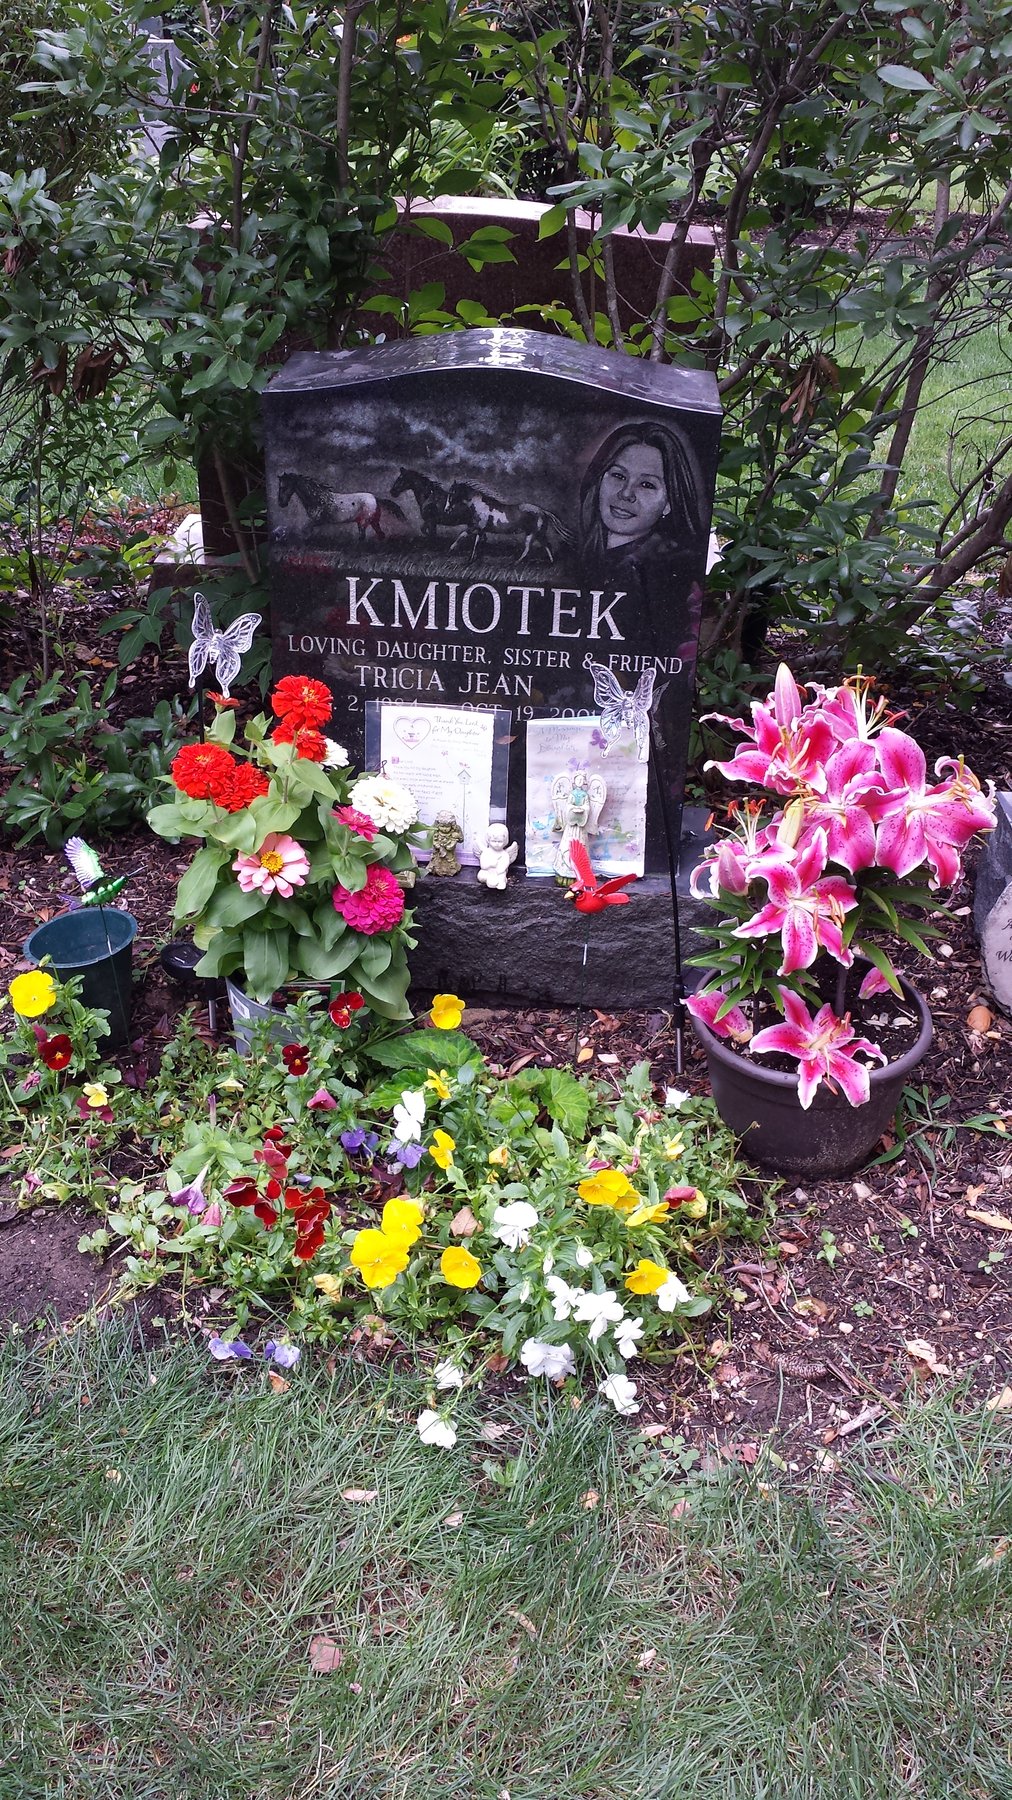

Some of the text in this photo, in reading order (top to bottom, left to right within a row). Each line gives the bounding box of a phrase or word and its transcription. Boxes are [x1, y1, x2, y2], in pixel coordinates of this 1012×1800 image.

[346, 577, 627, 640] KMIOTEK
[288, 635, 366, 656] LOVING
[503, 648, 571, 668] SISTER
[582, 652, 597, 670] &
[608, 654, 683, 674] FRIEND
[354, 665, 534, 697] TRICIA JEAN
